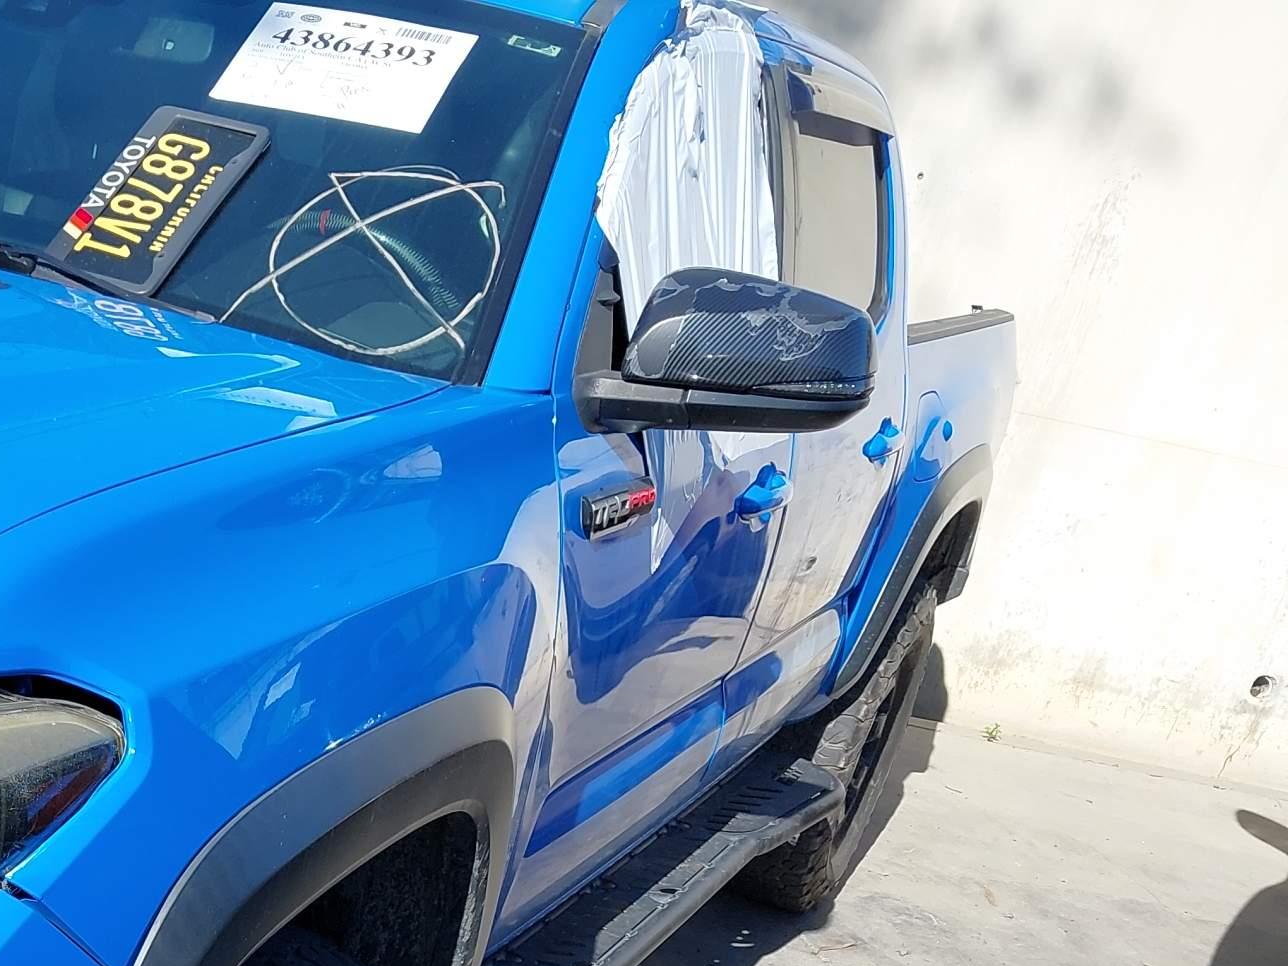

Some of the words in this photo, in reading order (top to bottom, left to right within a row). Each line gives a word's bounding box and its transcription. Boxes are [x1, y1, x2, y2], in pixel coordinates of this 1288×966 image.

[271, 27, 436, 67] 43864393
[73, 133, 211, 259] G878V1
[80, 136, 157, 209] TOYOTA
